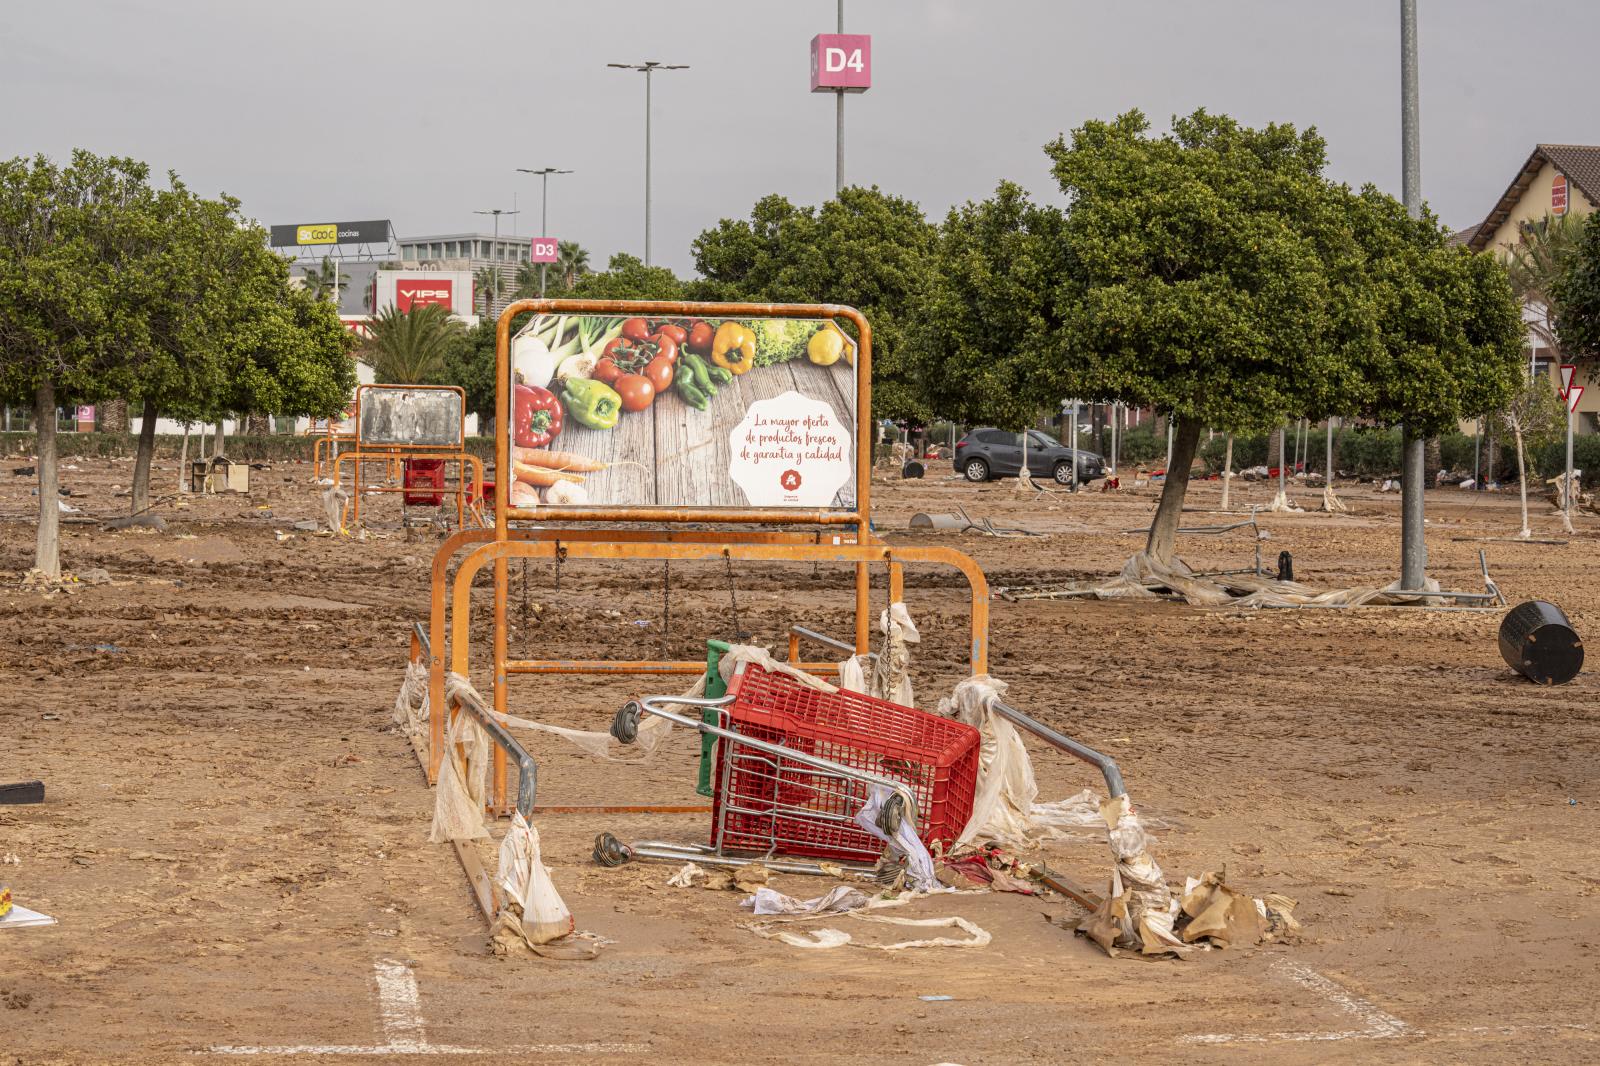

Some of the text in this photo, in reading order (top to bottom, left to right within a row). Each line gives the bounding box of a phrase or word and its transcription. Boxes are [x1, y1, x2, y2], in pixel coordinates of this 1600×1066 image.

[826, 48, 864, 72] D4
[338, 229, 360, 237] cocinas
[536, 244, 554, 256] D3
[400, 290, 449, 298] VIPS
[754, 413, 829, 432] La mayor oferta
[745, 429, 837, 446] de productos frescos
[740, 445, 751, 460] de
[796, 452, 802, 465] y
[805, 446, 842, 462] calidad
